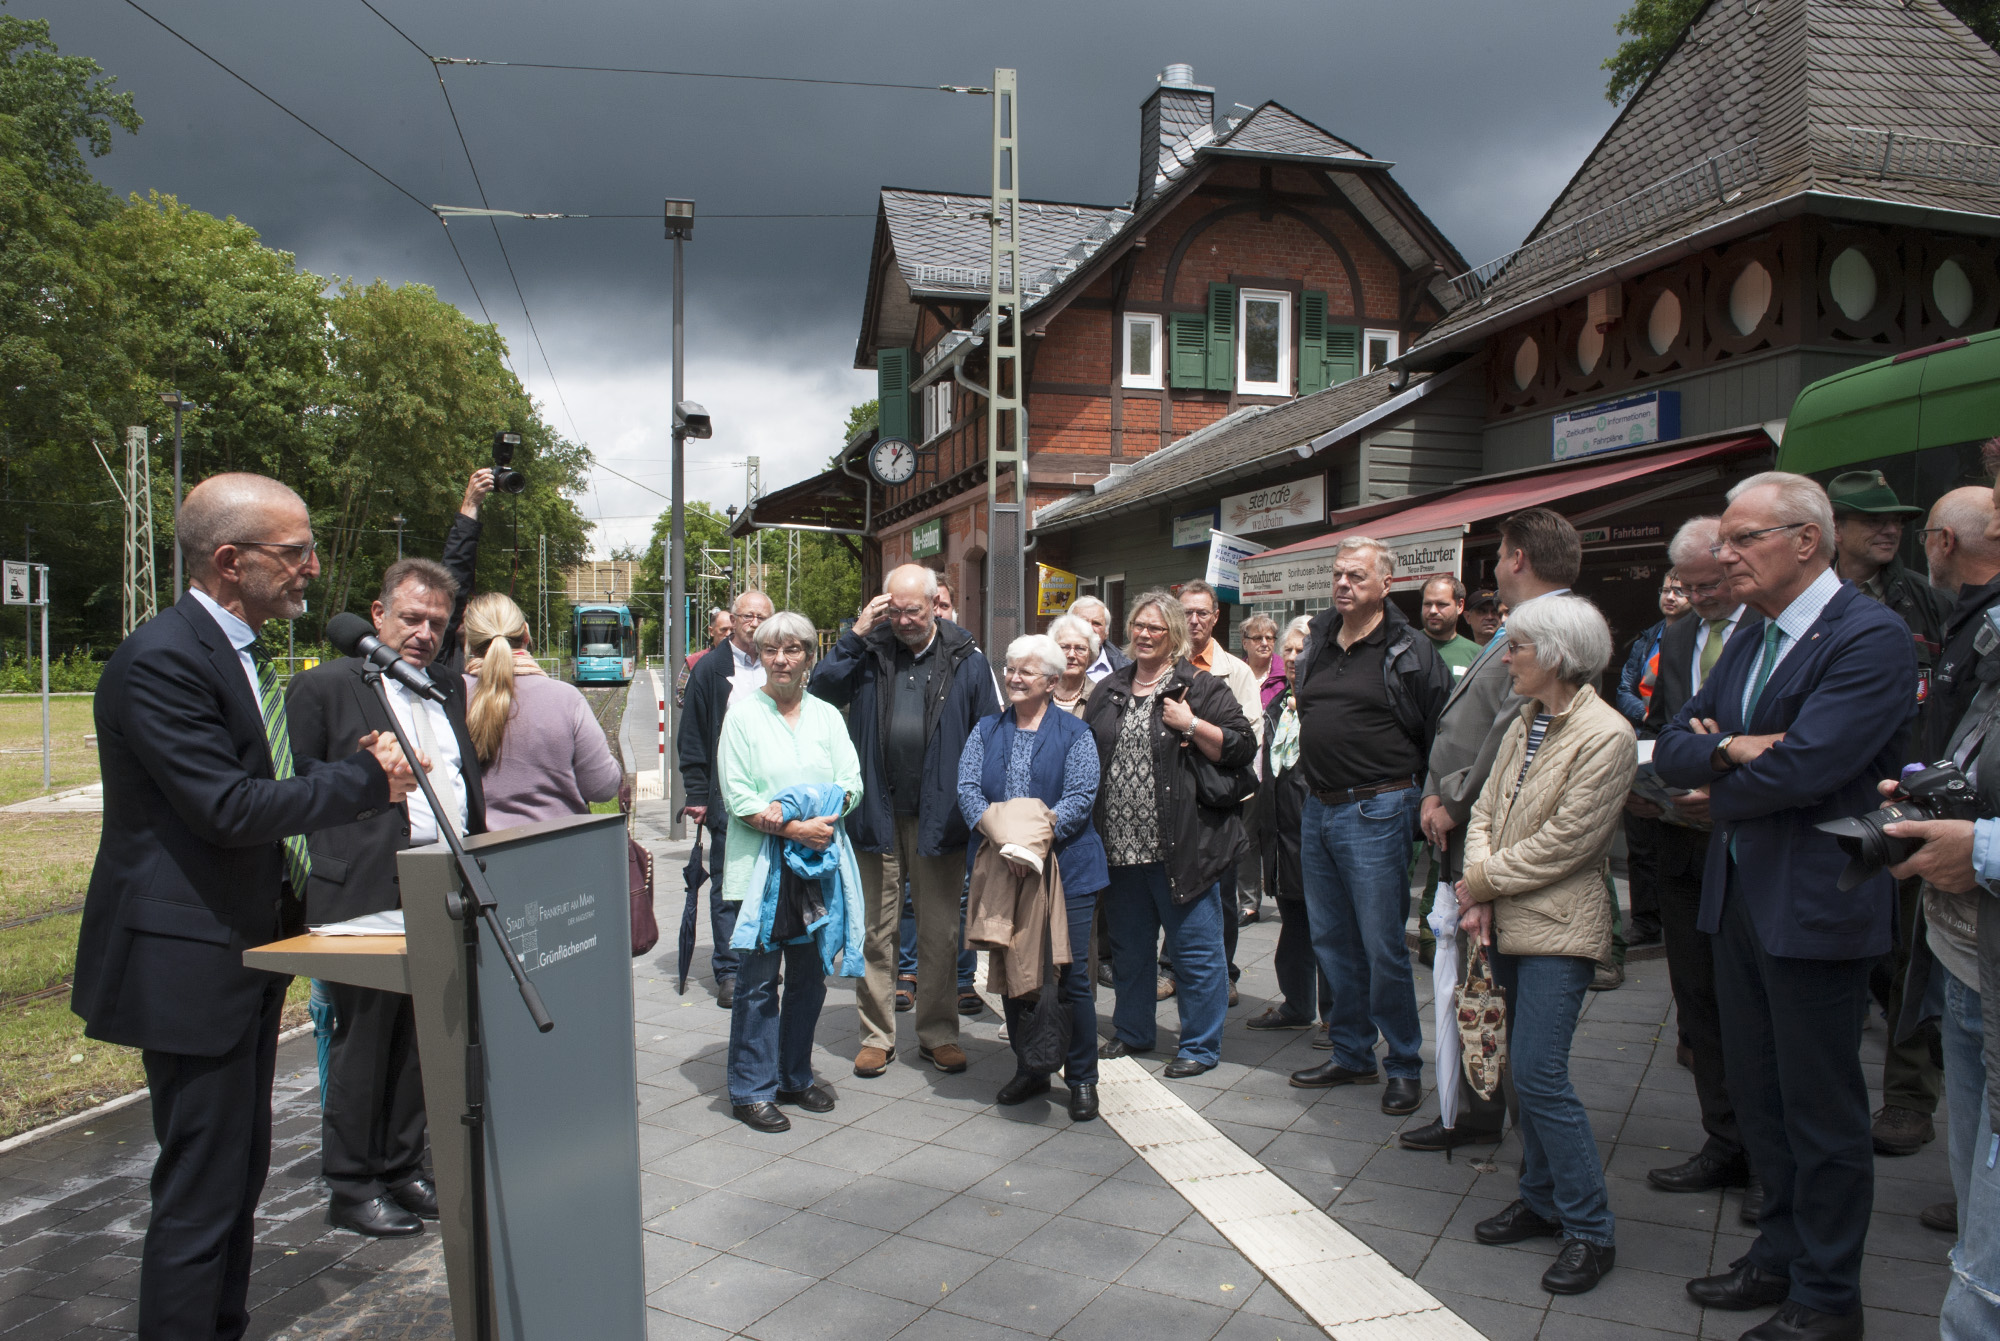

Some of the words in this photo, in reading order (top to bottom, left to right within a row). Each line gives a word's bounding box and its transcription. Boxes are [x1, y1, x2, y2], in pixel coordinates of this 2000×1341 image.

[1566, 426, 1597, 438] Zeitkarten
[1593, 433, 1623, 446] Fahrpläne
[1249, 490, 1269, 509] steh
[1252, 513, 1284, 530] waldbahn
[912, 526, 939, 551] Neu-Isenburg
[1613, 526, 1660, 539] Fahrkarten
[1242, 570, 1283, 585] Frankfurter
[1288, 583, 1305, 592] Kaffee
[1306, 580, 1331, 591] Getränke
[539, 906, 570, 921] FRANKFURT
[570, 900, 579, 911] AM
[579, 893, 595, 908] MAIN
[1953, 920, 1977, 934] JONES
[540, 934, 597, 967] Grünflächenamt
